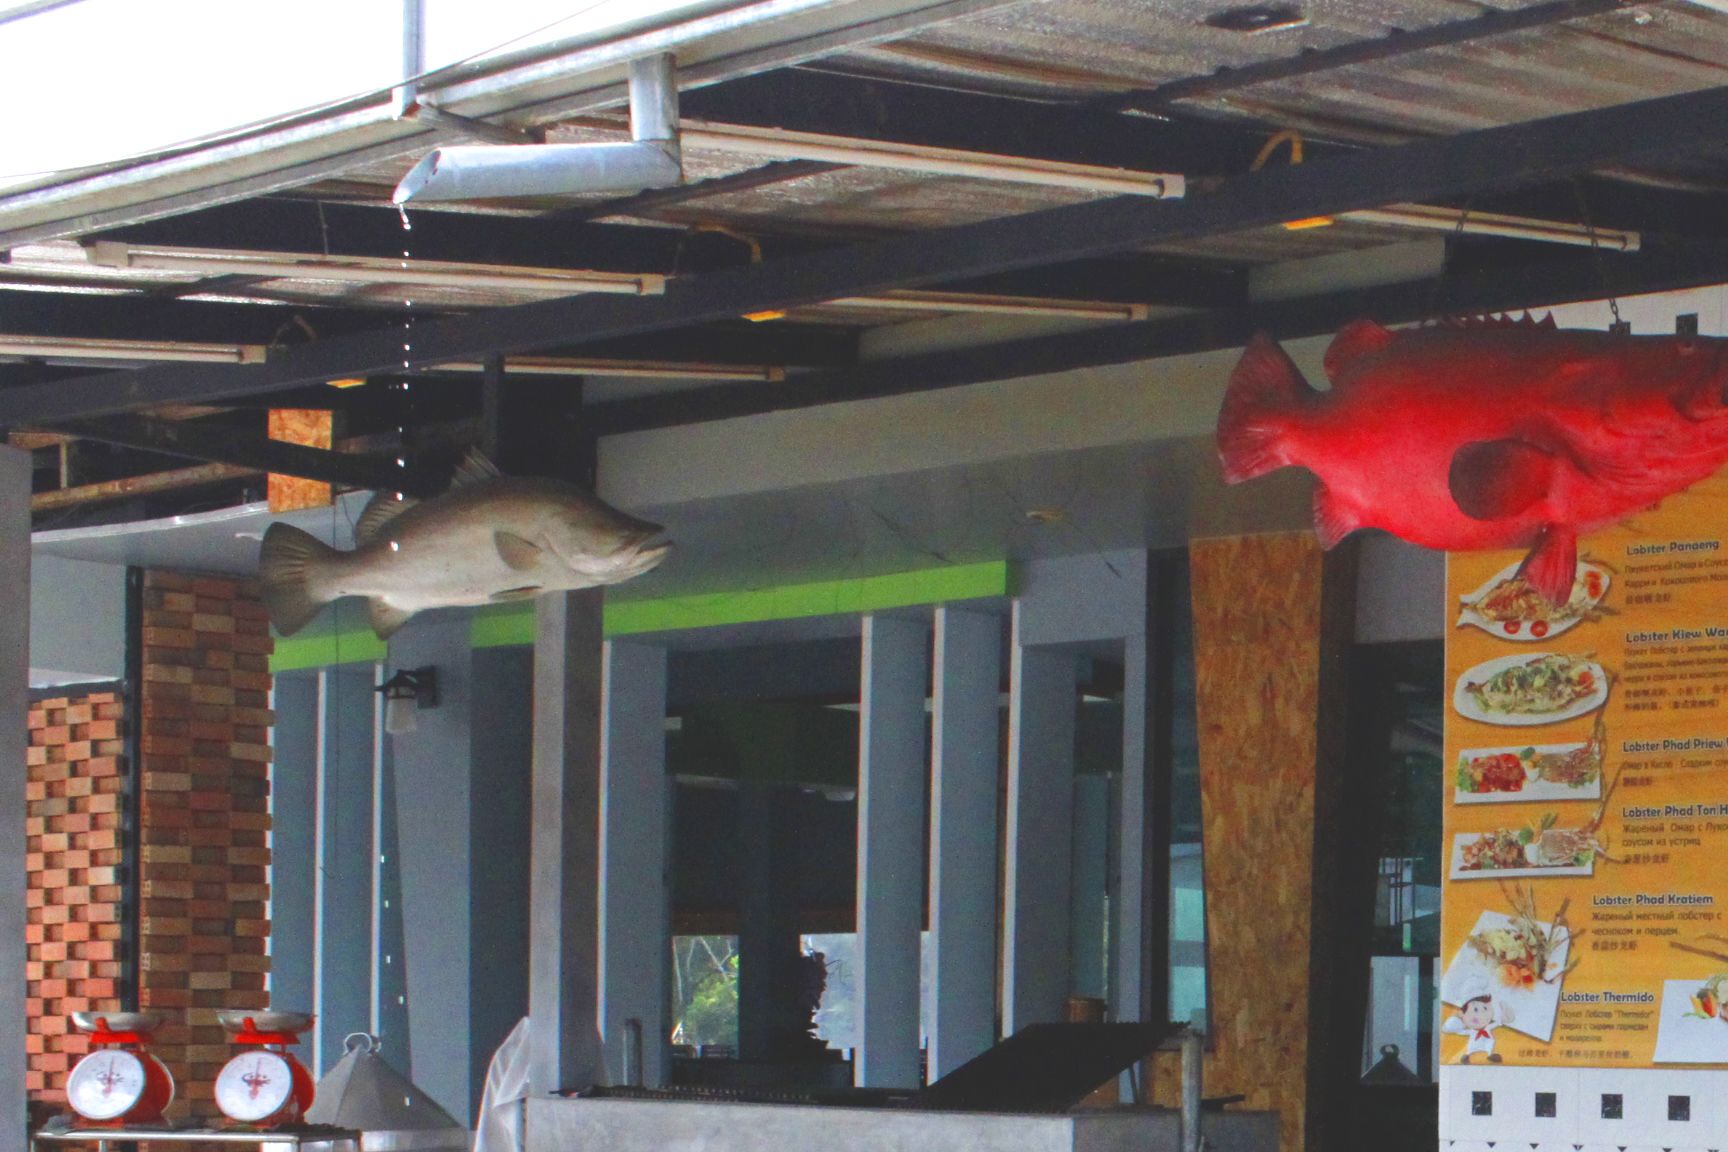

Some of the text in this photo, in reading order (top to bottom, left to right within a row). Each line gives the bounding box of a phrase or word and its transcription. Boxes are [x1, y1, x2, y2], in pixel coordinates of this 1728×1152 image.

[1626, 633, 1668, 642] Lobster
[1673, 630, 1701, 640] Kiew
[1623, 741, 1659, 752] Lobster
[1663, 739, 1689, 750] Phad
[1694, 739, 1722, 748] Priew
[1623, 808, 1660, 817] Lobster
[1665, 806, 1693, 816] Phad
[1697, 805, 1716, 815] Ton
[1593, 896, 1632, 905] Lobster
[1636, 895, 1664, 904] Phad
[1561, 992, 1600, 1002] Lobster
